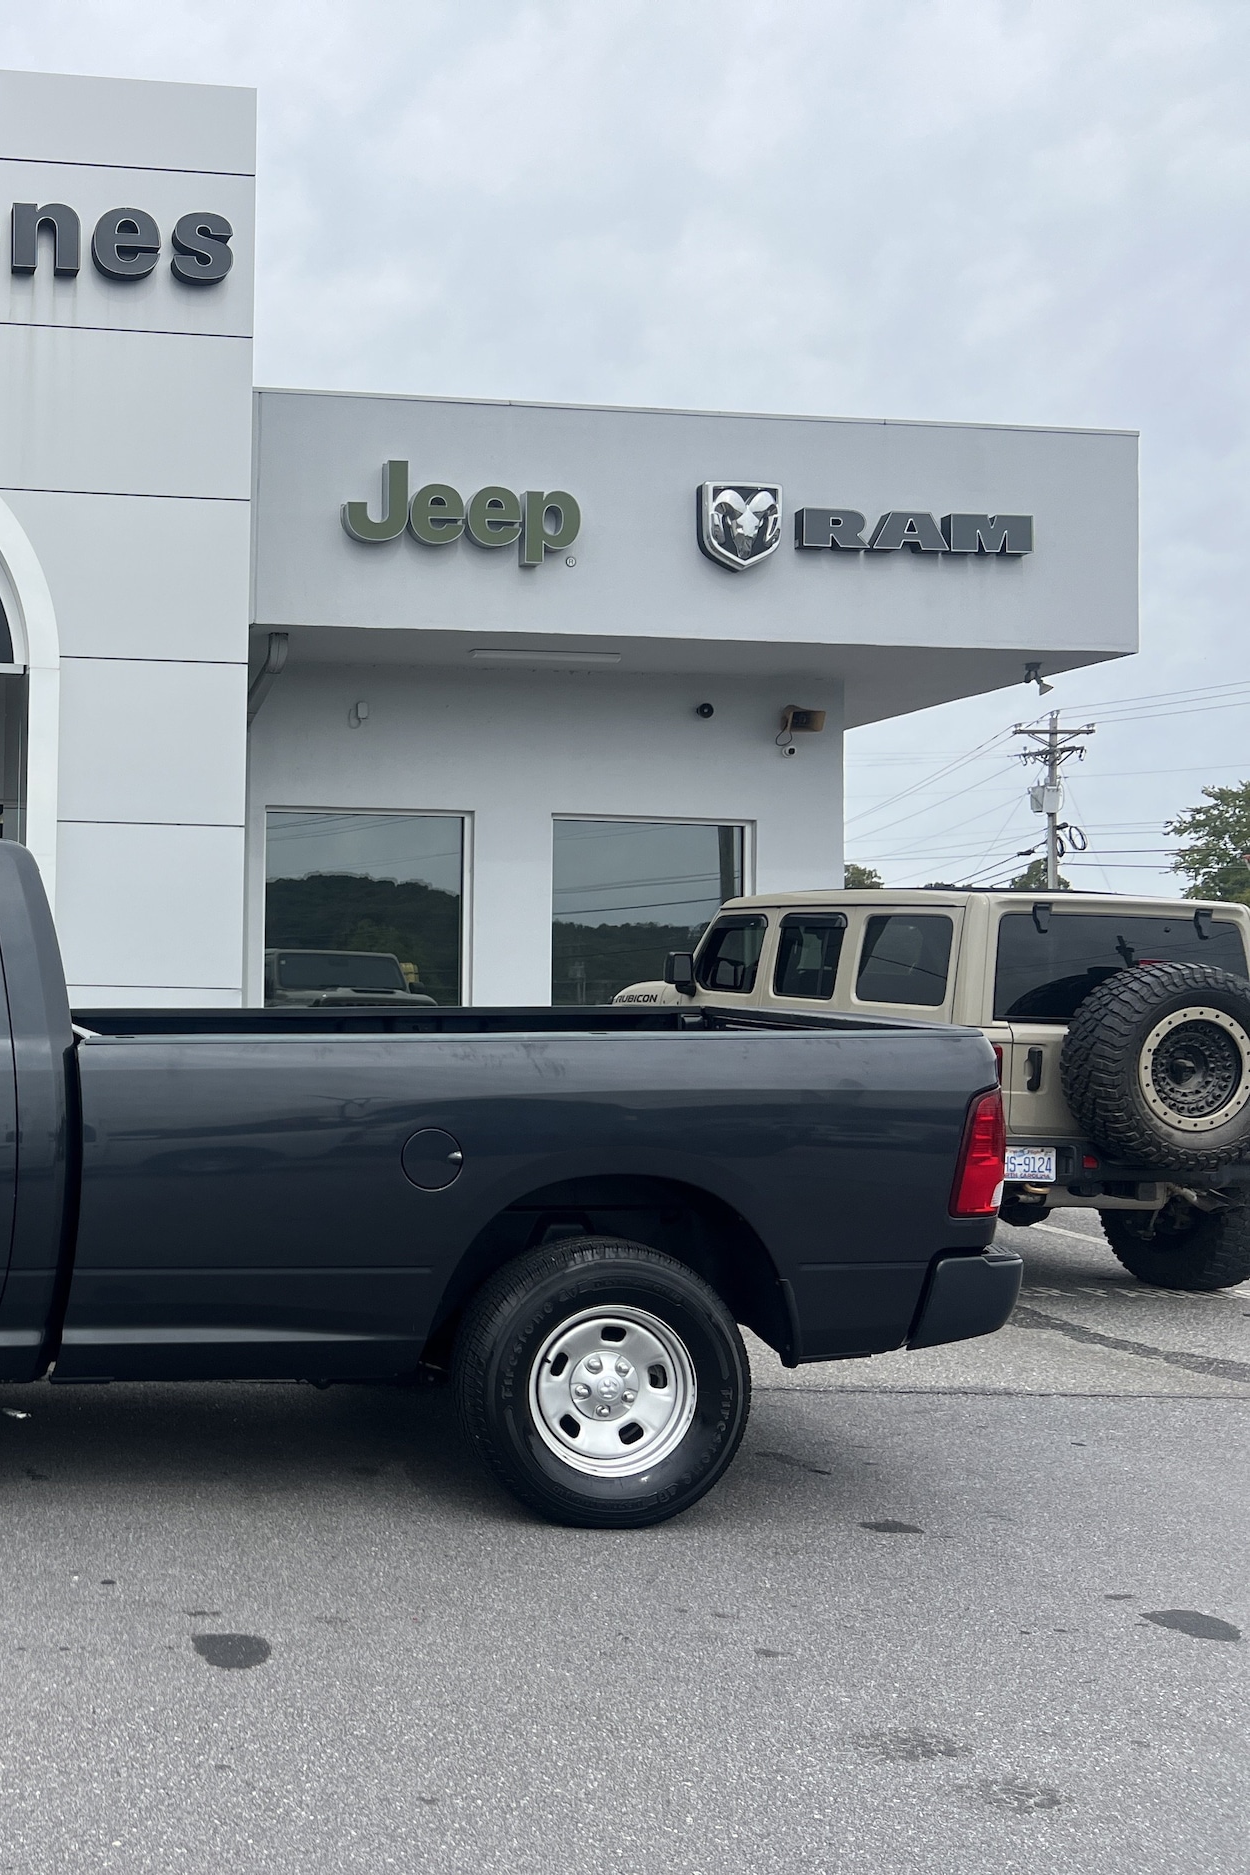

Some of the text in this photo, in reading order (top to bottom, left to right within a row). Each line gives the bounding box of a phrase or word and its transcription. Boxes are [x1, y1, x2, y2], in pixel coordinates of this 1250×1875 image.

[340, 459, 582, 568] Jeep
[793, 506, 1035, 556] RAM
[615, 994, 658, 1004] RUBICON
